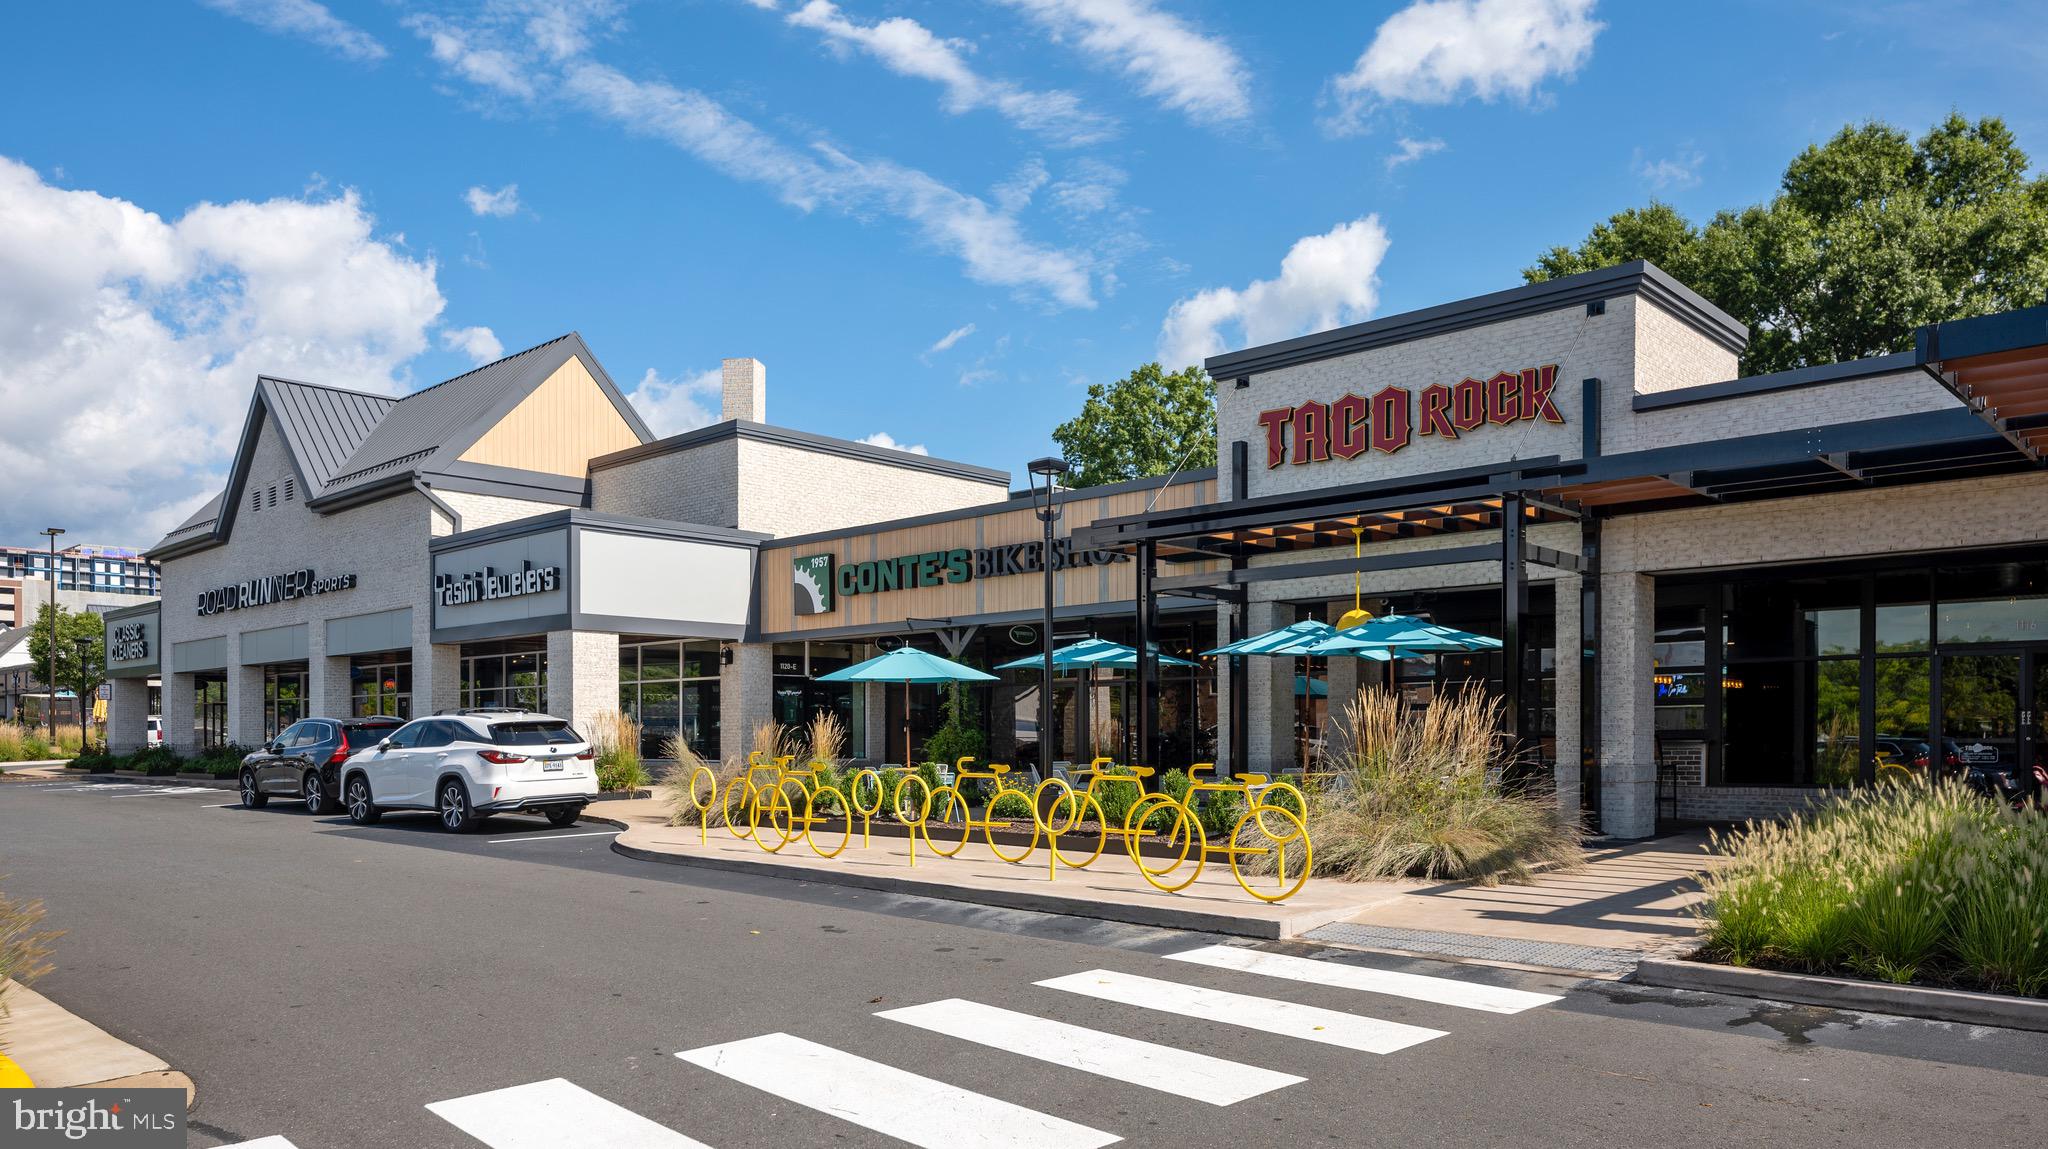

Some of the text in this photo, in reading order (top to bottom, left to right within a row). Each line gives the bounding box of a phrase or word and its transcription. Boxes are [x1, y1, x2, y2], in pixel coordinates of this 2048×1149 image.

[1258, 364, 1566, 469] TACO ROCK
[811, 556, 828, 568] 1957
[838, 548, 973, 597] CONTE'S
[974, 540, 1044, 579] BIKE
[311, 574, 357, 596] SPORTS
[434, 559, 560, 606] Yasini Jewelers
[114, 623, 144, 643] CLASSIC
[111, 641, 148, 661] CLEANERS
